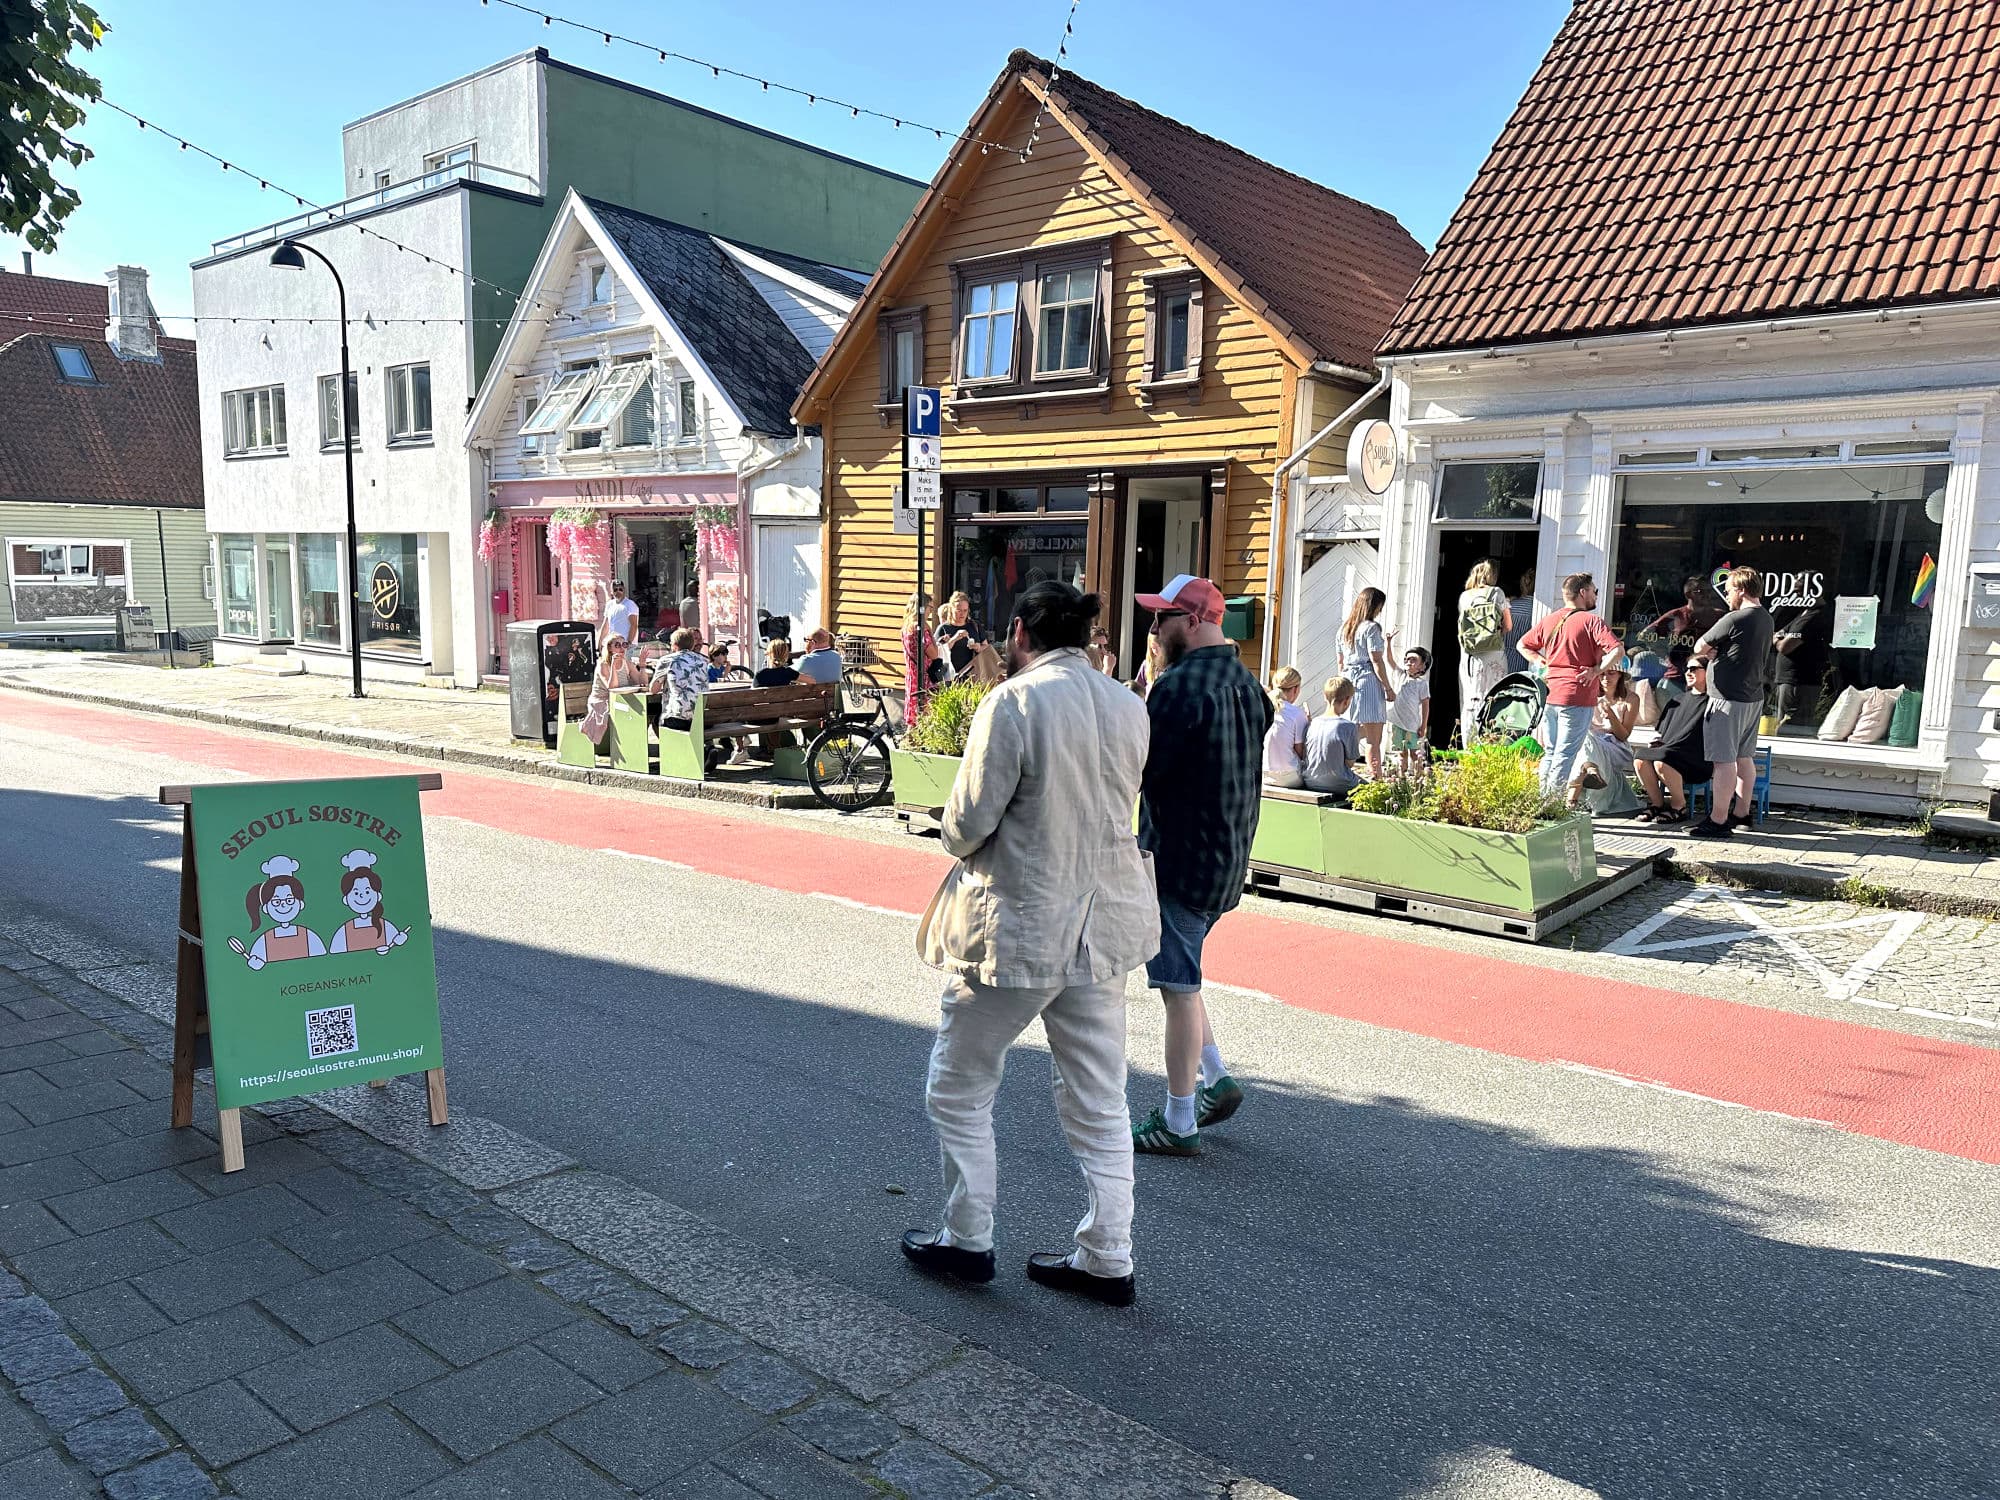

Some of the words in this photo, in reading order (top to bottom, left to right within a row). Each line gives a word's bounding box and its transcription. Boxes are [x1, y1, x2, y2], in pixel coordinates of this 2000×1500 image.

[916, 393, 933, 429] P
[914, 456, 919, 464] 9
[929, 457, 936, 465] 12
[918, 476, 932, 484] Maks
[575, 479, 625, 503] SANDI
[1769, 592, 1817, 613] gelato
[228, 608, 247, 620] DROP
[1630, 612, 1652, 625] OPEN
[371, 620, 401, 631] FRISØR
[1669, 633, 1695, 648] 18:00
[220, 807, 304, 860] SEOUL
[308, 804, 403, 848] SØSTRE
[280, 977, 347, 997] KOREANSK
[348, 974, 373, 987] MAT
[239, 1044, 425, 1089] https://seoulsostre.munu.shop/
